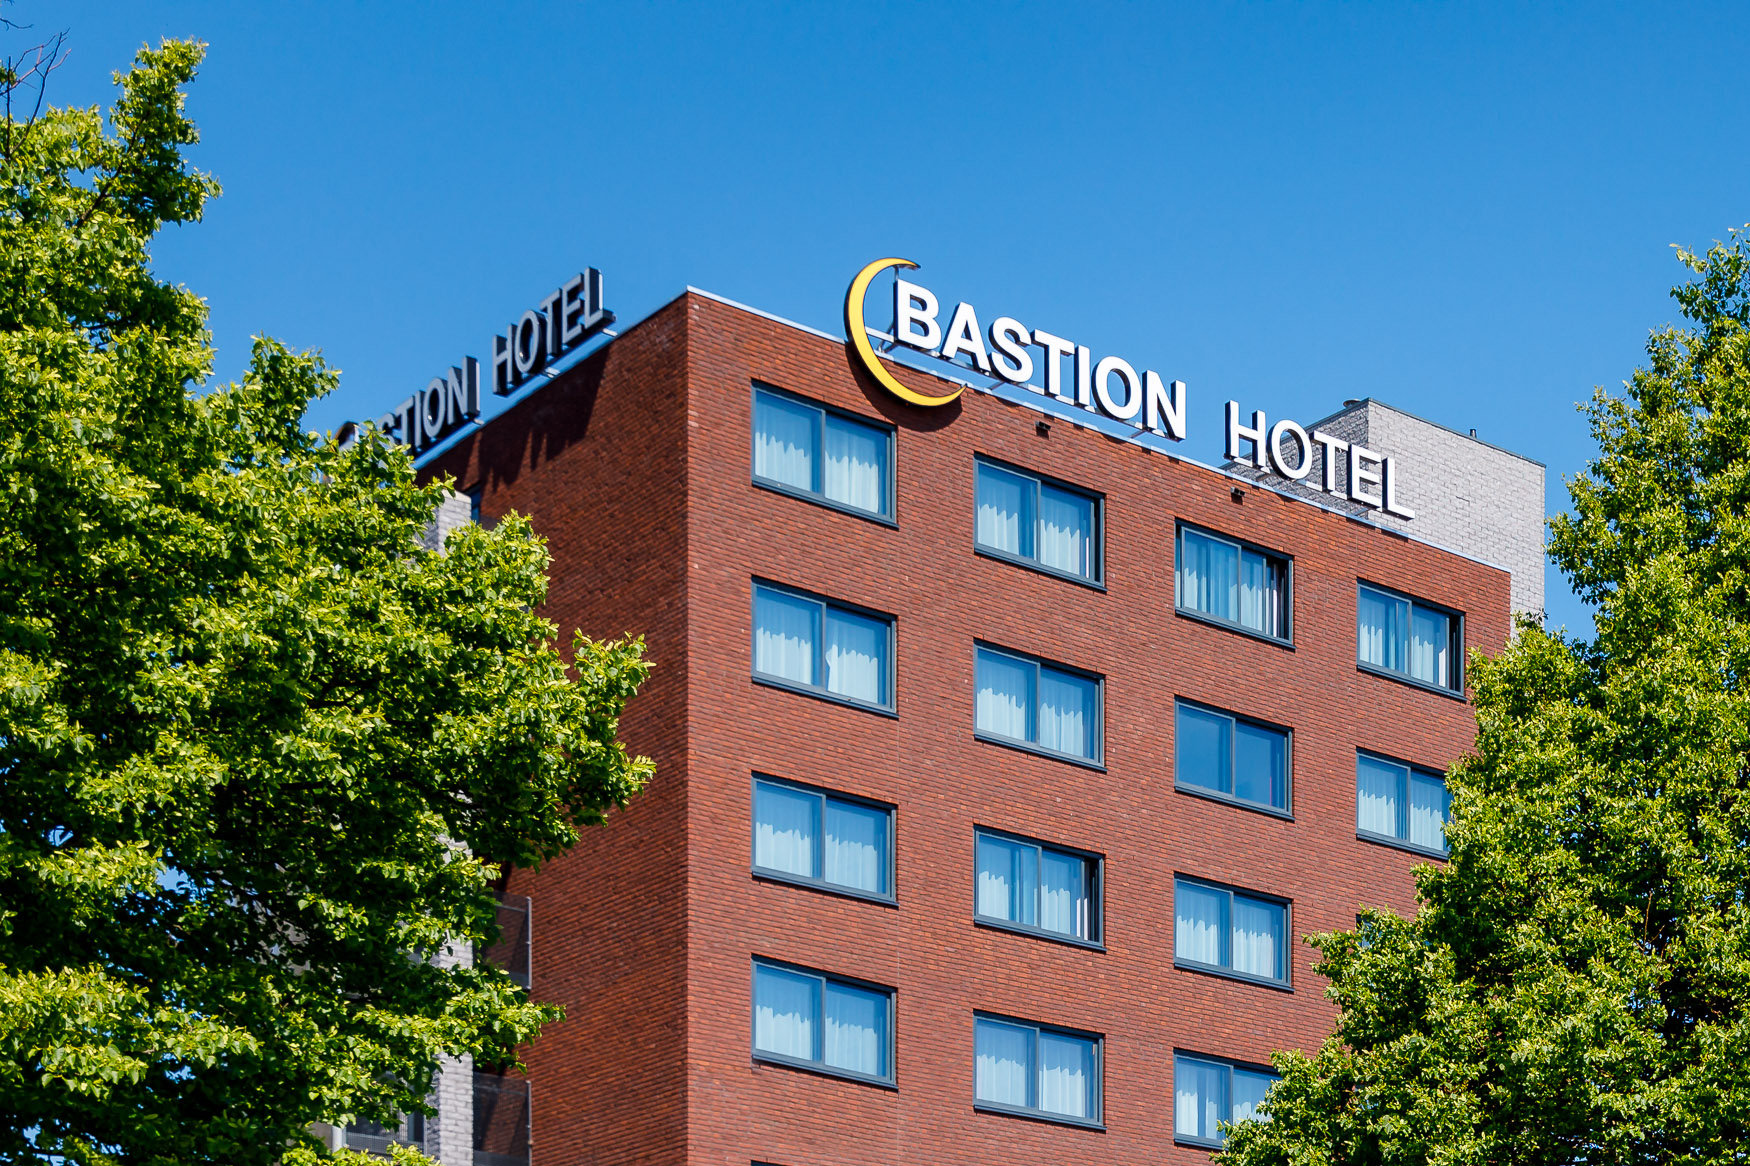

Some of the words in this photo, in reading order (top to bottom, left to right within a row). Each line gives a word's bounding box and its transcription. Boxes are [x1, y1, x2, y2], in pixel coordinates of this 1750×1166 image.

[340, 355, 480, 460] STION
[492, 265, 616, 397] HOTEL
[894, 278, 1187, 441] BASTION
[1224, 399, 1415, 521] HOTEL
